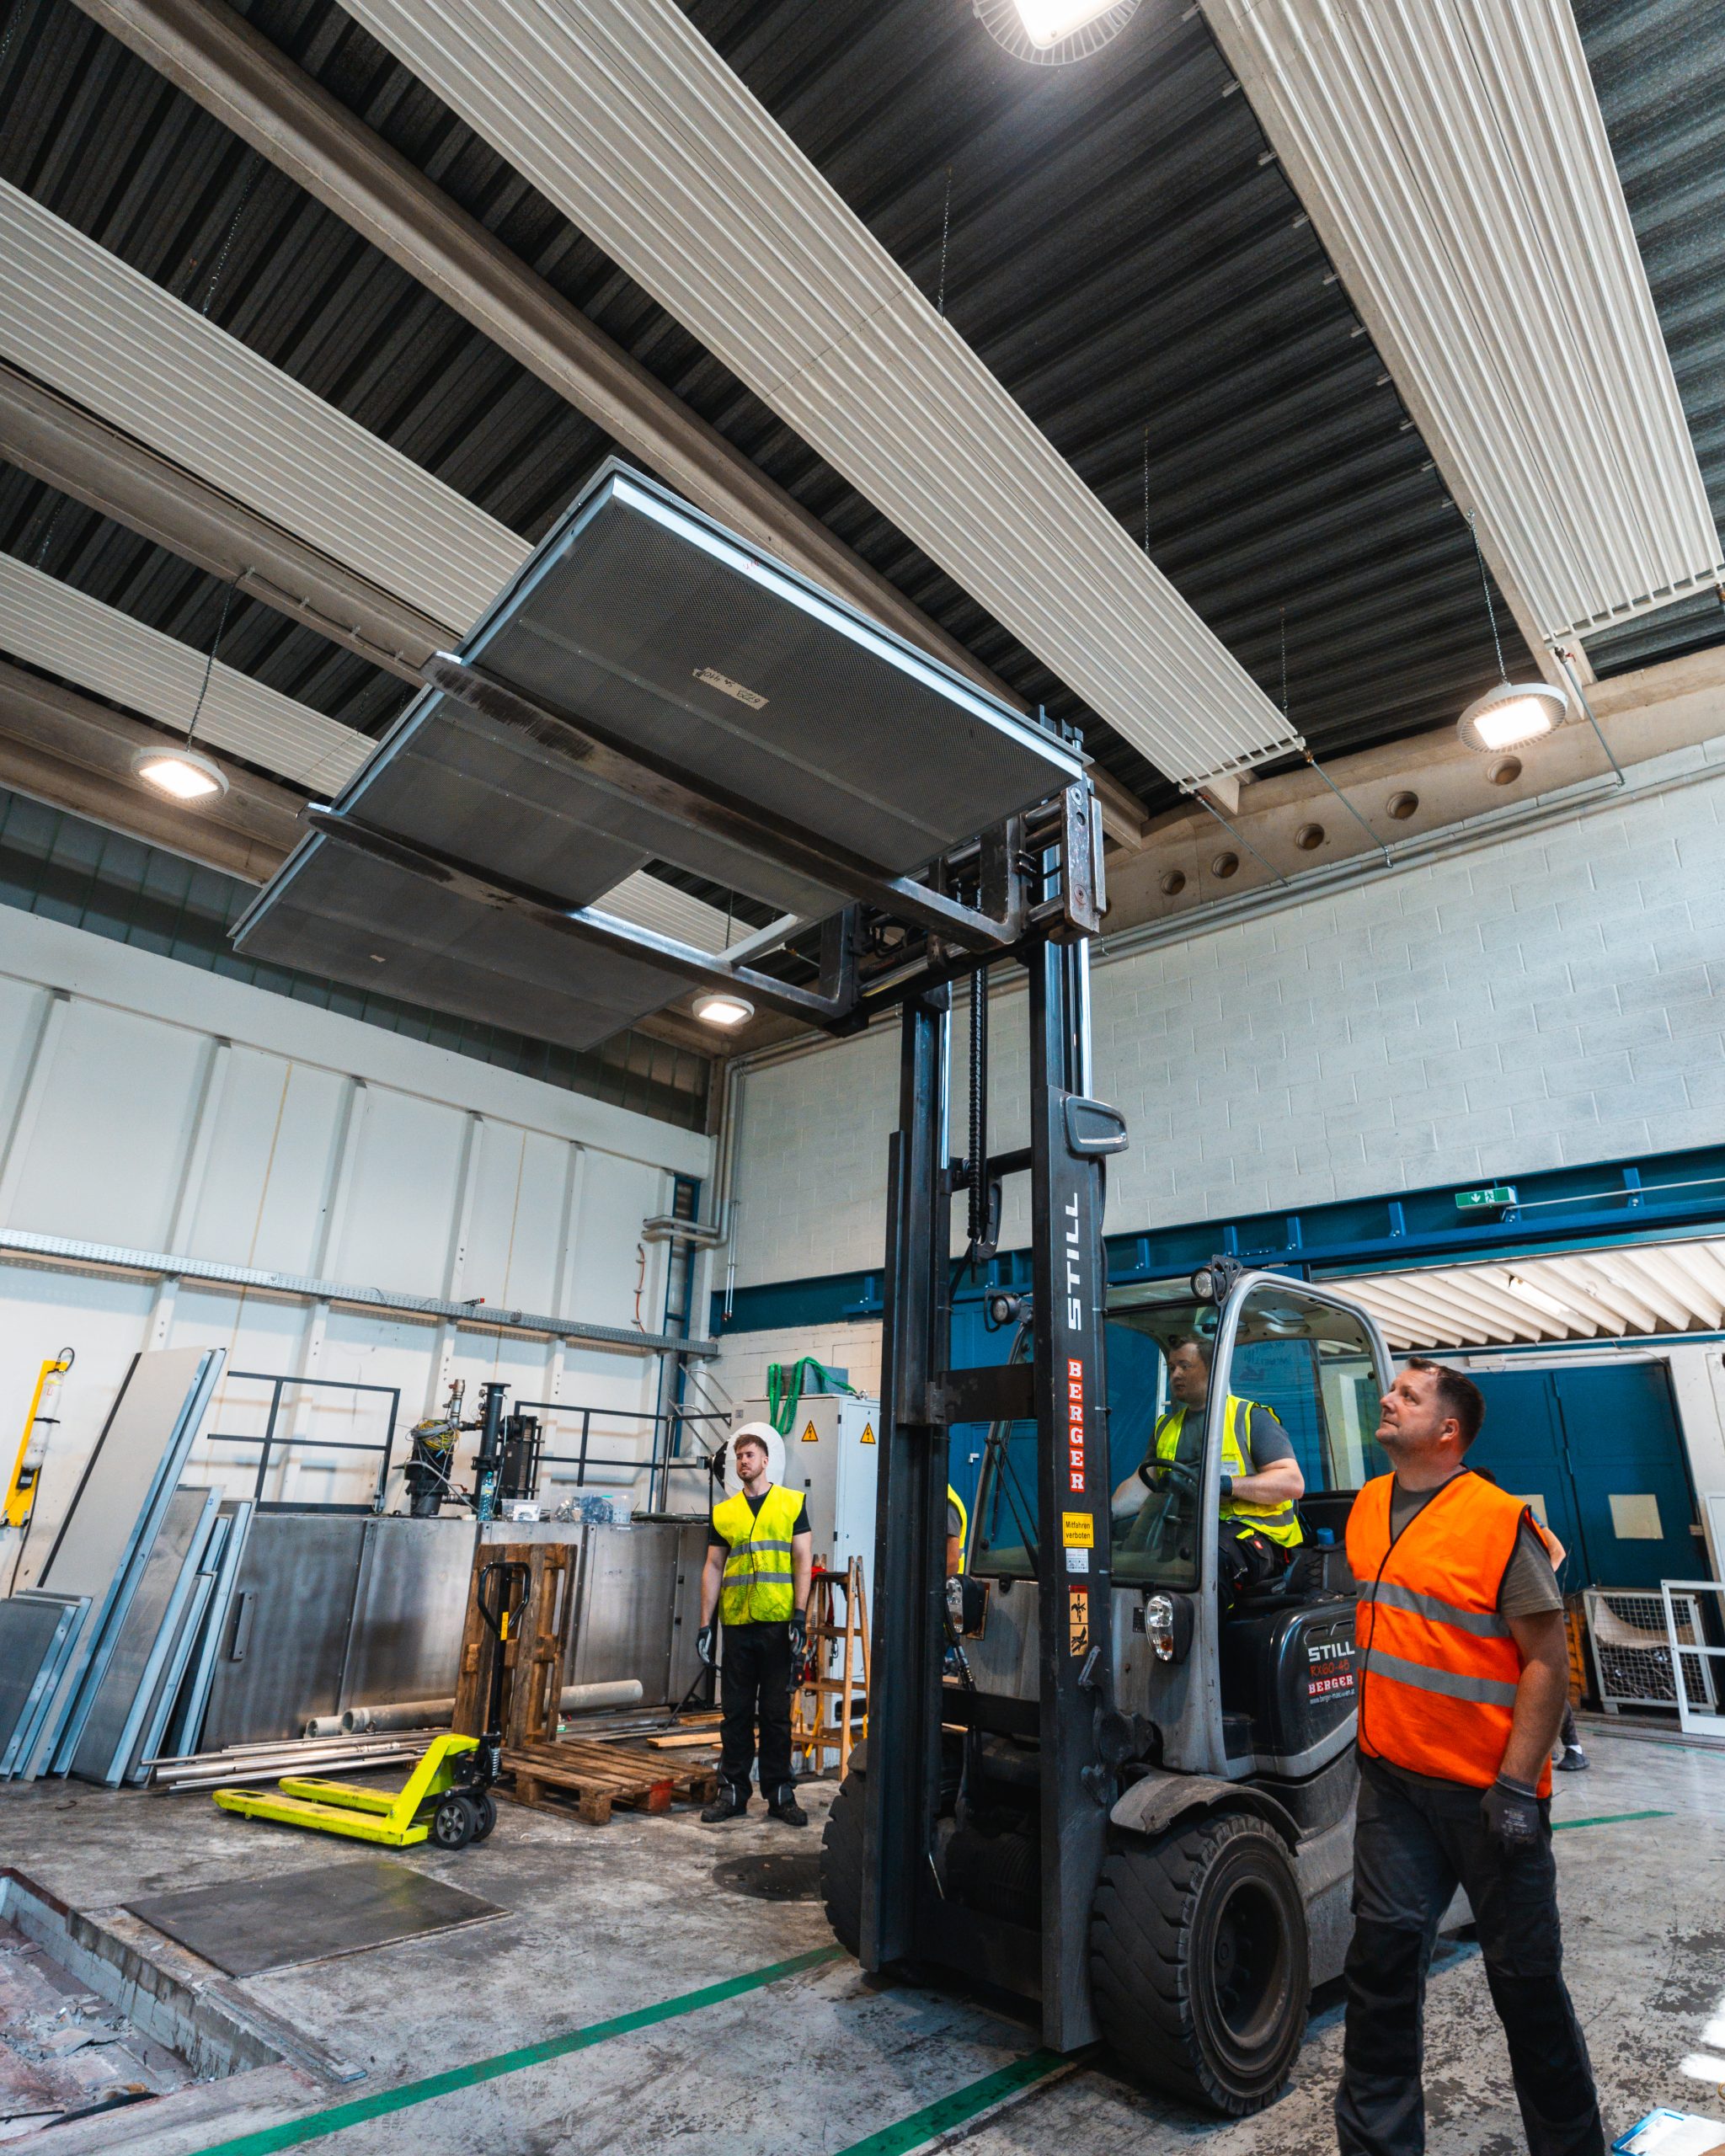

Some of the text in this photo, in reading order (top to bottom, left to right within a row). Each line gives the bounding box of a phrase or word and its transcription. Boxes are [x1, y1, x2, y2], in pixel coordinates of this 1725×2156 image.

[1065, 1192, 1081, 1331] STILL
[1068, 1361, 1084, 1490] BERGER
[1065, 1520, 1091, 1529] Mitfahren
[1065, 1531, 1091, 1540] verboten
[1307, 1641, 1355, 1662] STILL
[1308, 1674, 1354, 1694] BERGER
